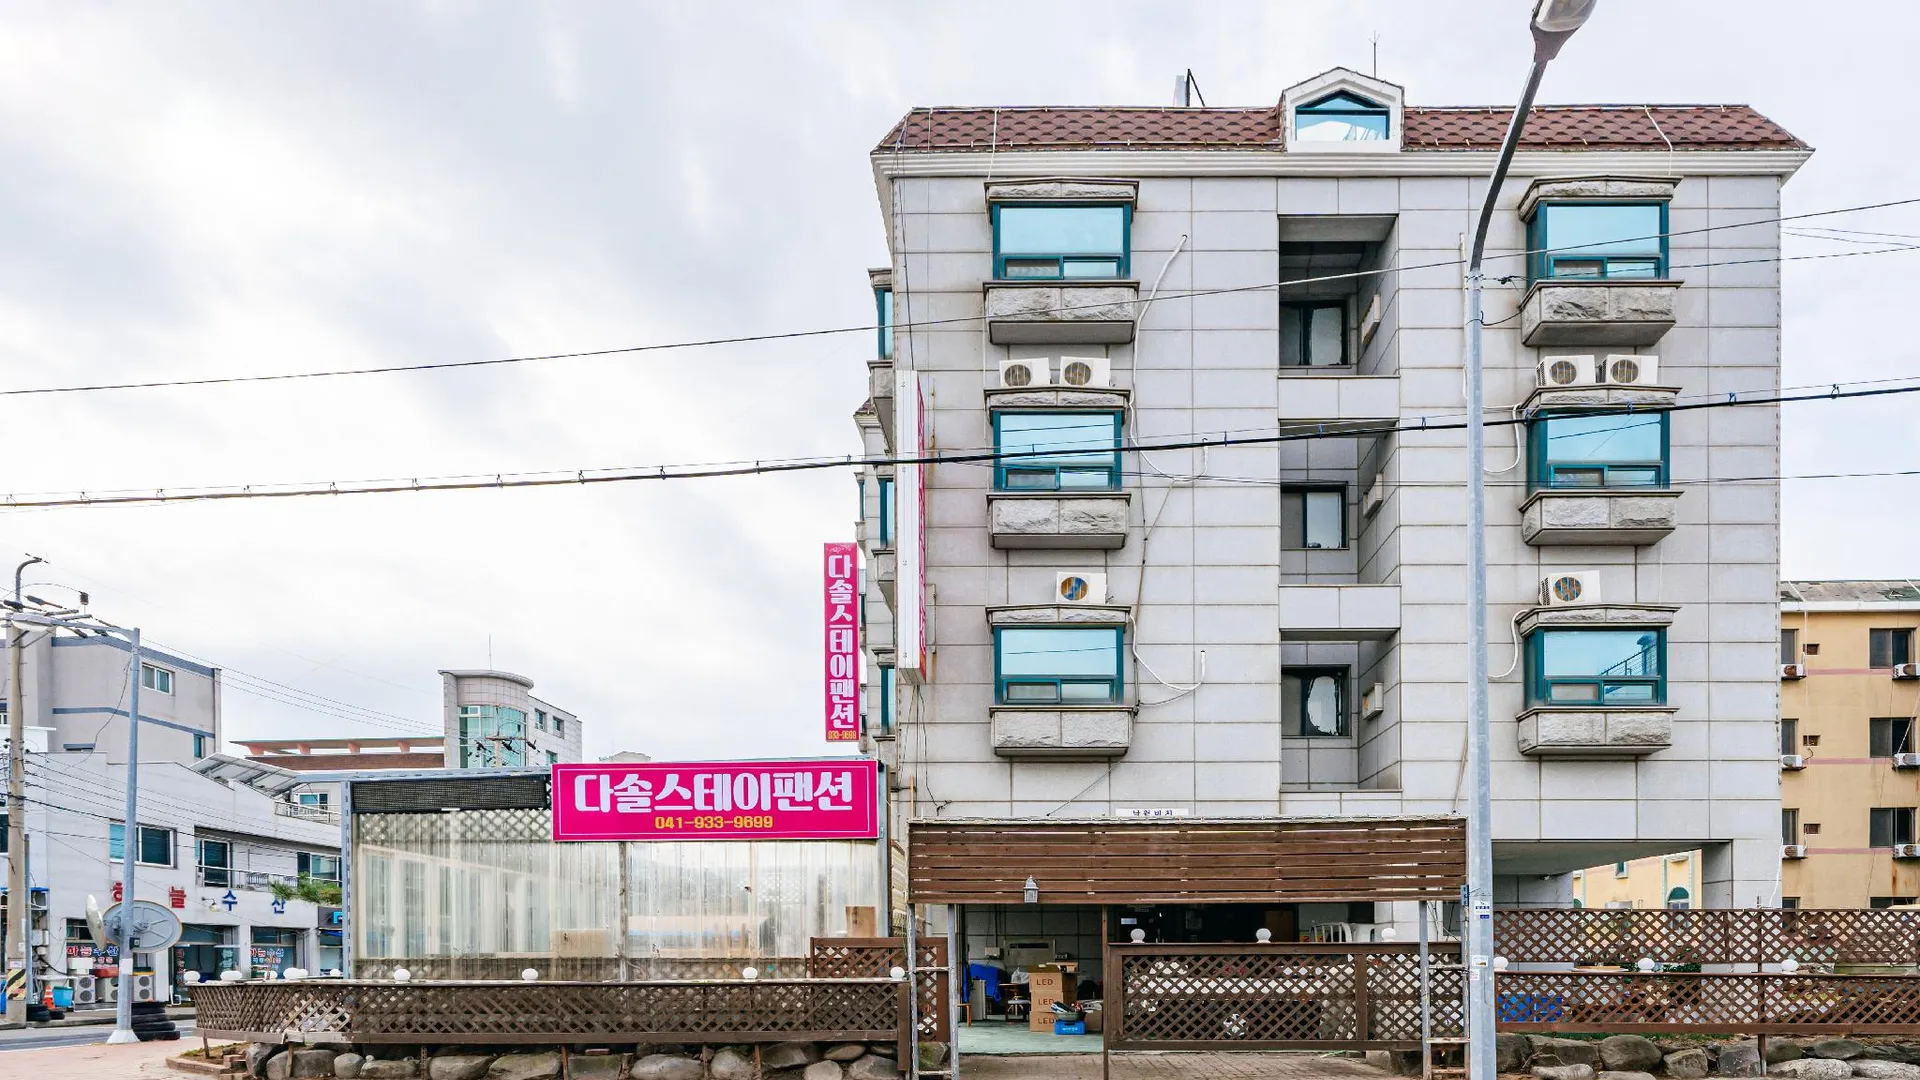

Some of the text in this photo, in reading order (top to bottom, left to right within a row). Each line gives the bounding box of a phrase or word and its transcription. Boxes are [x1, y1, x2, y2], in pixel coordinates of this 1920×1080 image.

[574, 771, 853, 813] 다솔스테이팬션
[655, 815, 774, 829] 041-933-9699
[1036, 978, 1054, 986] LED
[1037, 1017, 1055, 1025] LED
